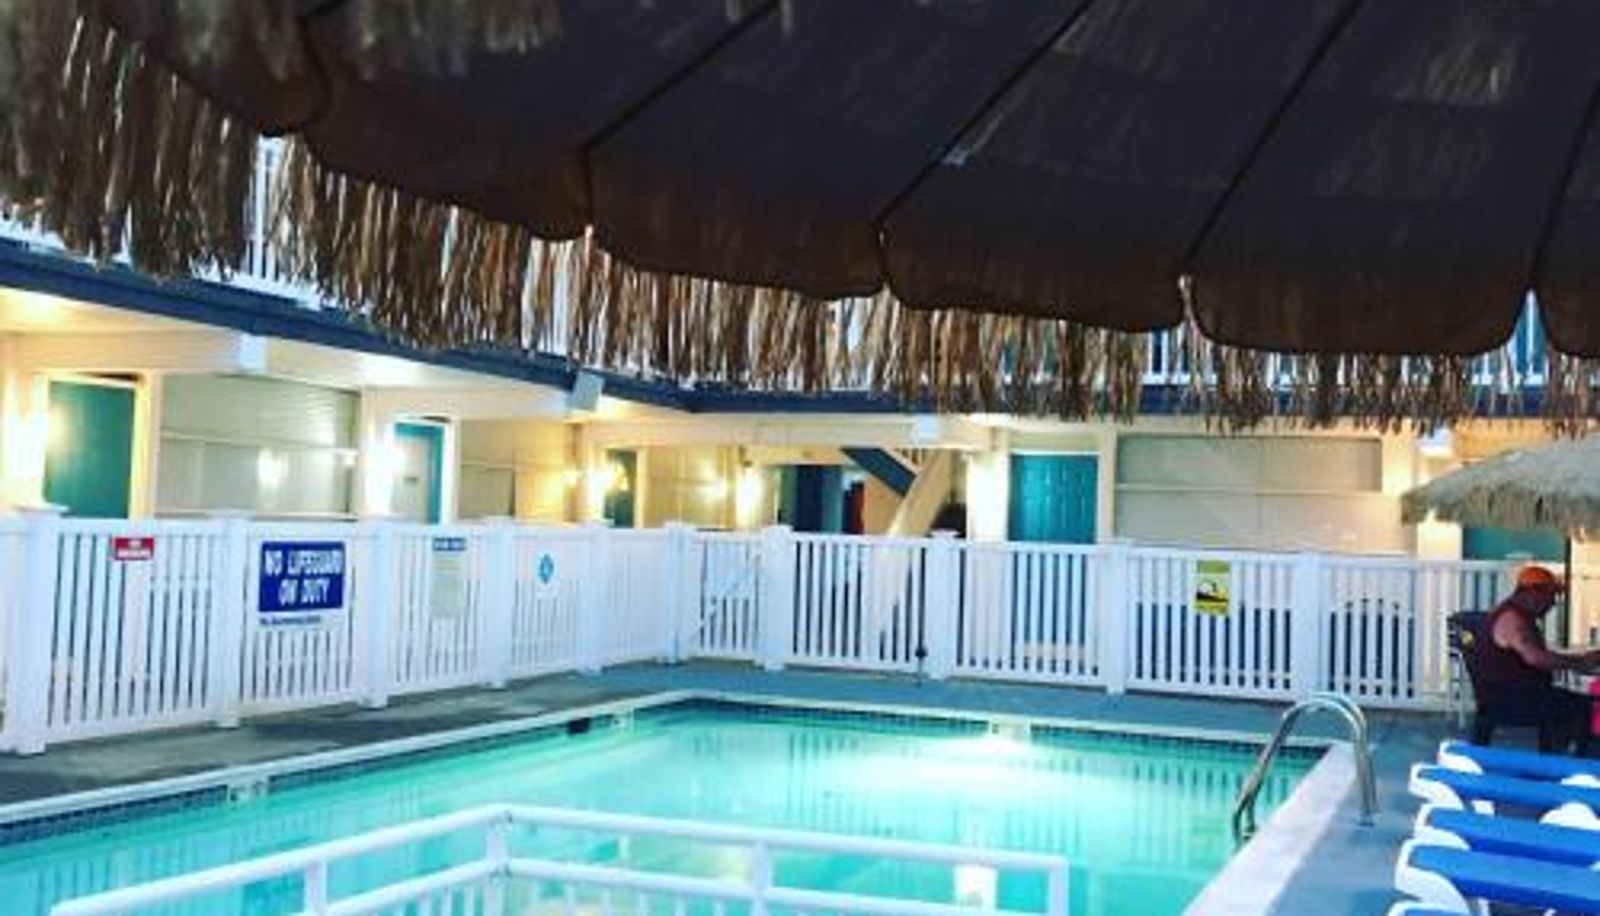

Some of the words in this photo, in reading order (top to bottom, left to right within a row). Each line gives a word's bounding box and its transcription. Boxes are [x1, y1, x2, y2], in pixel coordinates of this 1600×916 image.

[265, 550, 282, 577] NO
[287, 549, 343, 574] LIFEGUARD
[280, 579, 299, 605] ON
[301, 577, 330, 603] DUTY
